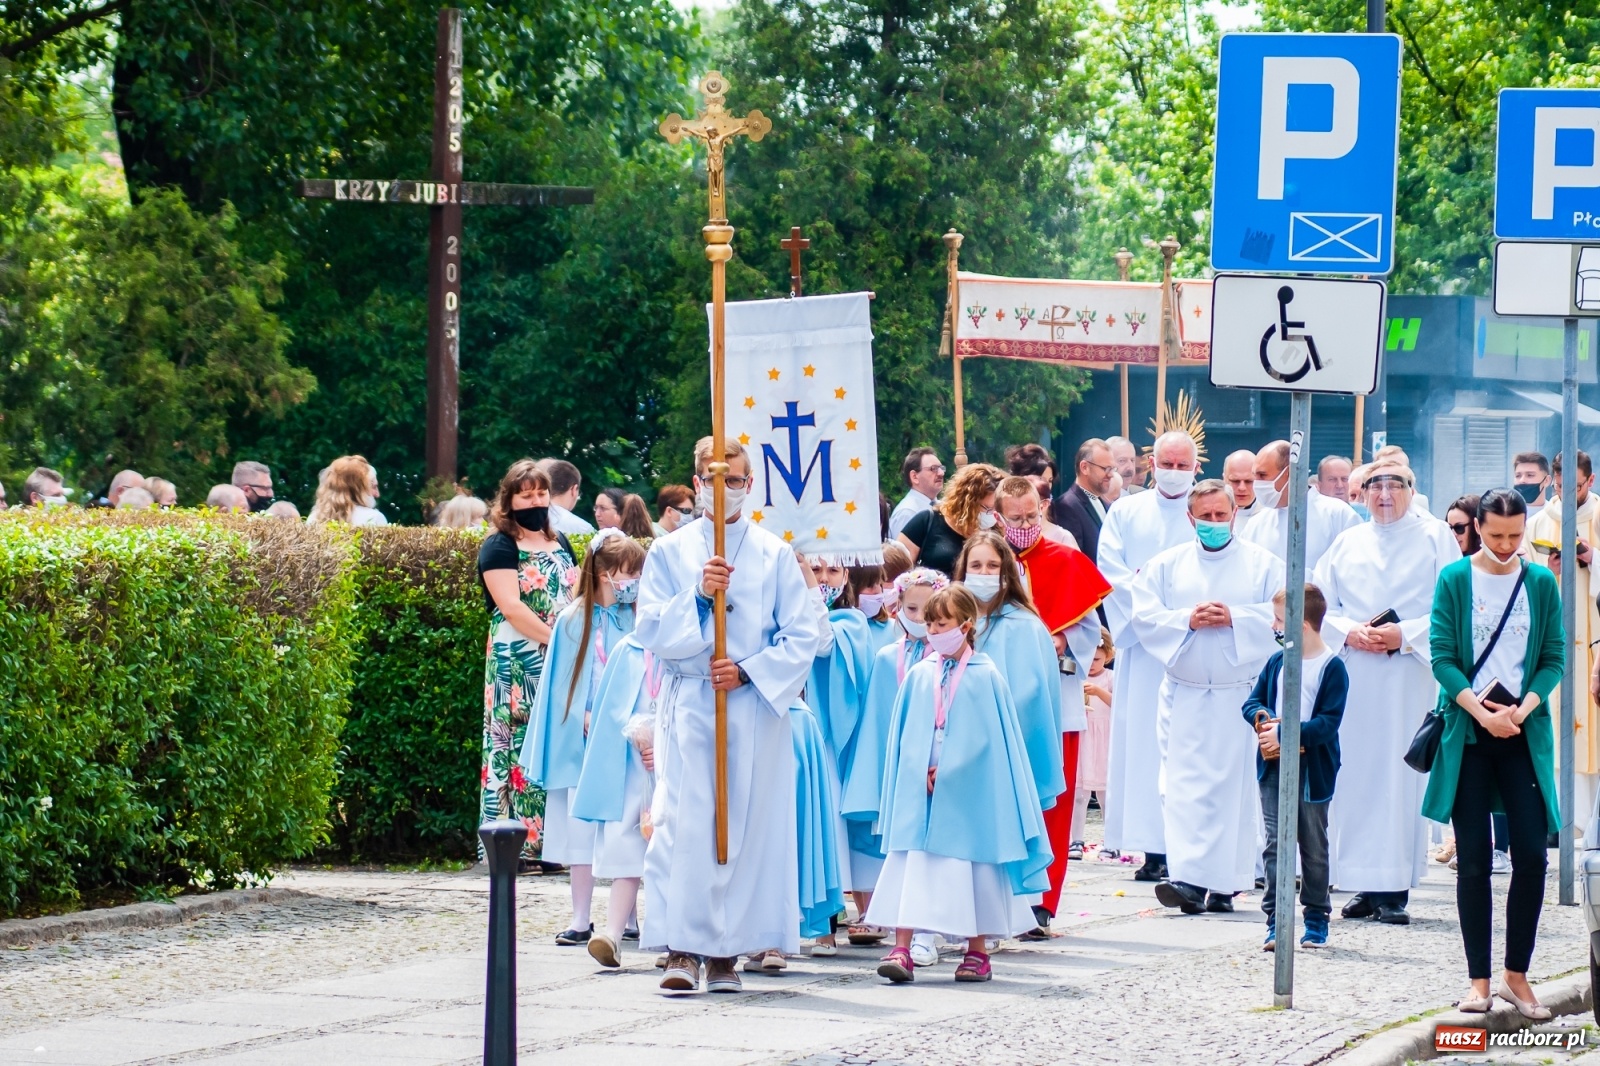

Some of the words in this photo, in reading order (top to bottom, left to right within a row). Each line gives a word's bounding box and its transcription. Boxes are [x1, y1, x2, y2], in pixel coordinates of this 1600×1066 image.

[1257, 56, 1360, 200] P
[1531, 106, 1600, 220] P
[1385, 317, 1422, 350] H
